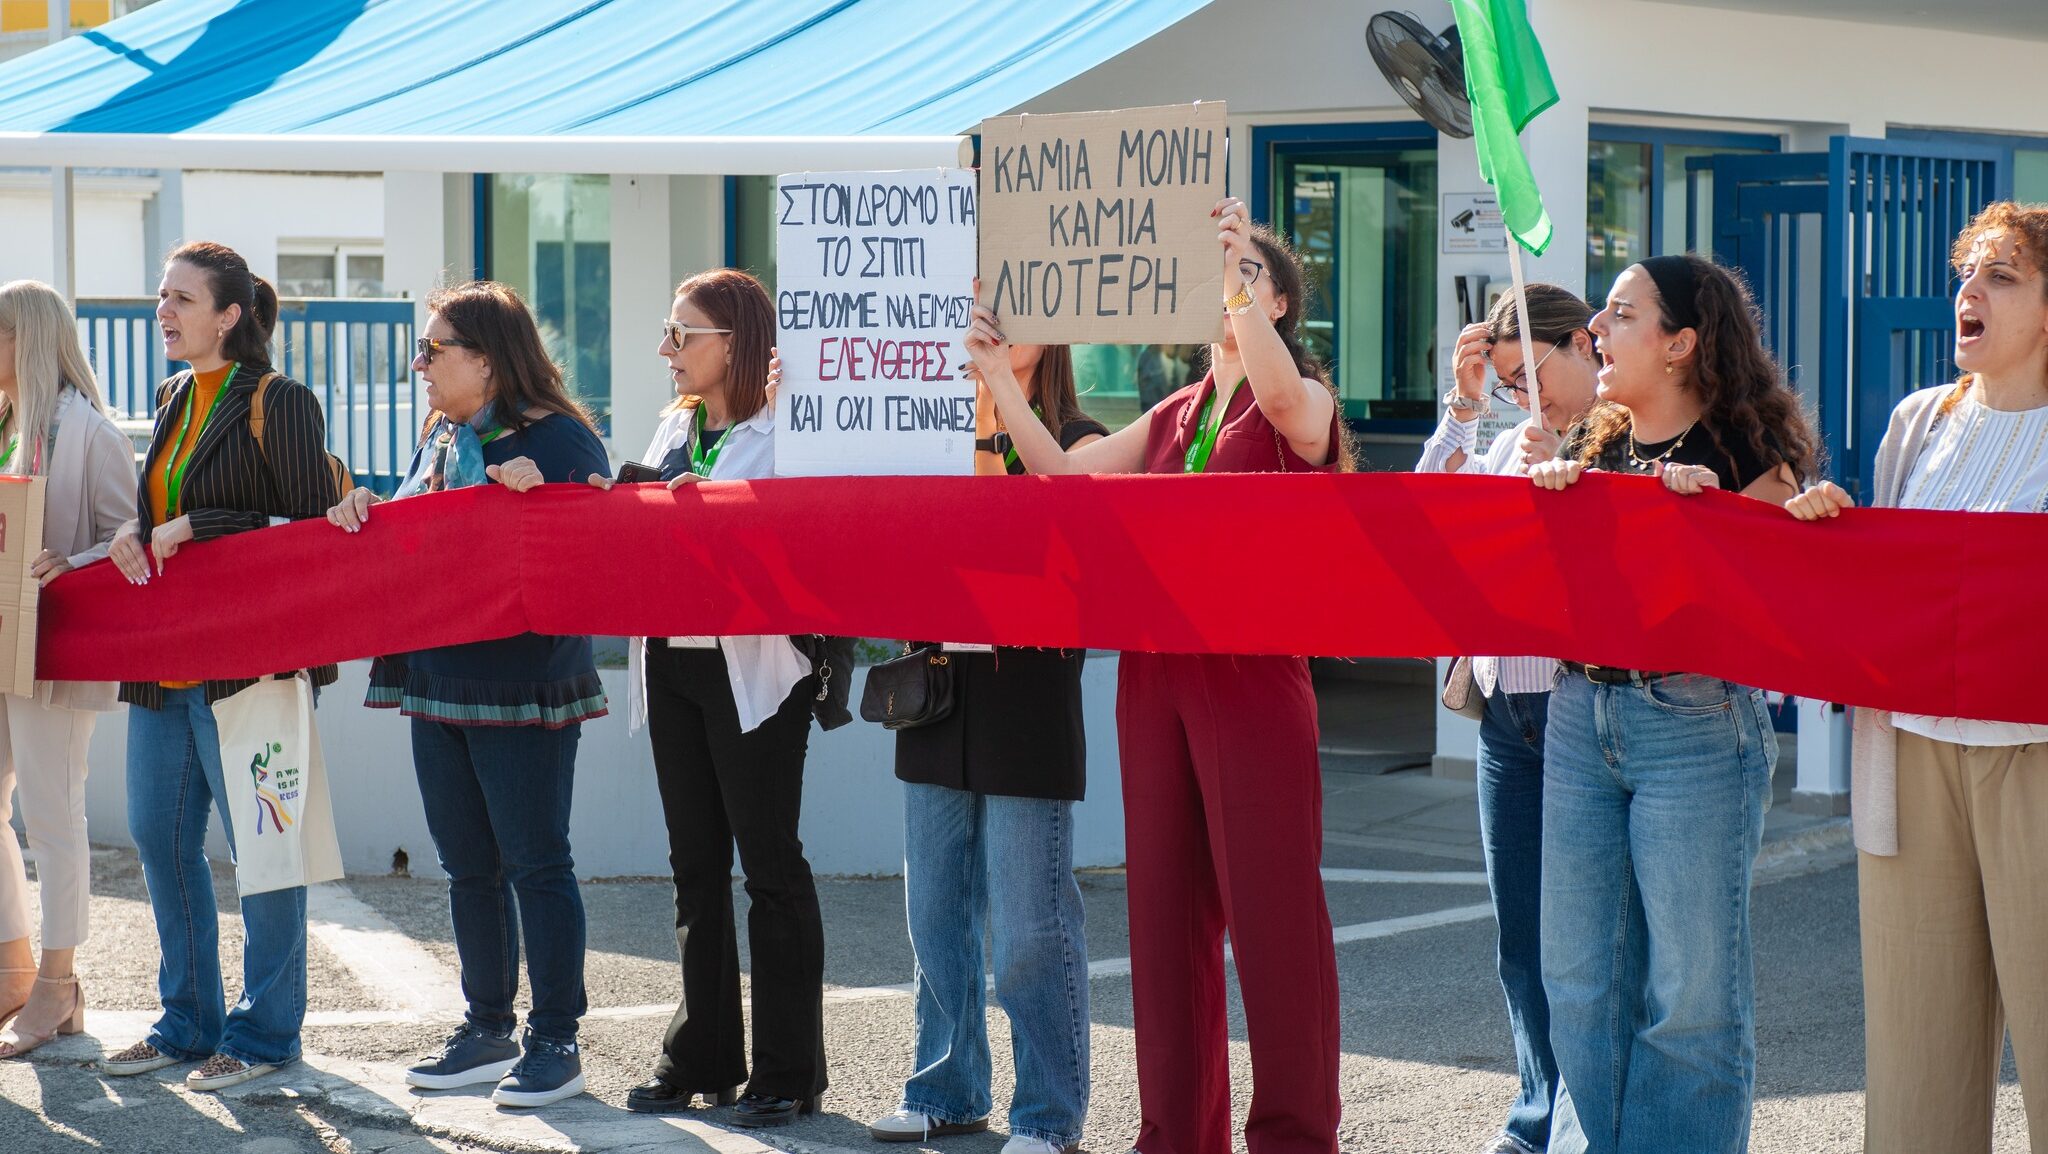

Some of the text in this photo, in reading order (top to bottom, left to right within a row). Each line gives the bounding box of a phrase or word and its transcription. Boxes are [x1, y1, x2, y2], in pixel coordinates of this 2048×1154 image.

[995, 127, 1212, 193] ΚΑΜΙΑ ΜΟΝΗ
[780, 183, 976, 228] ΣΤΟΝ ΔΡΟΜΟ ΓΙΑ
[1050, 198, 1157, 247] ΚΑΜΙΑ
[817, 235, 926, 279] ΤΟ ΣΠΙΤΙ
[993, 254, 1178, 317] ΛΙΓΟΤΕΡΗ
[778, 290, 879, 330] ΘΕΛΟΥΜΕ
[886, 293, 917, 329] ΝΑ
[819, 336, 954, 381] ΕΛΕΥΘΕΡΕΣ
[790, 394, 976, 433] ΚΑΙ ΟΧΙ ΓΕΝΝΑΙΕΣ
